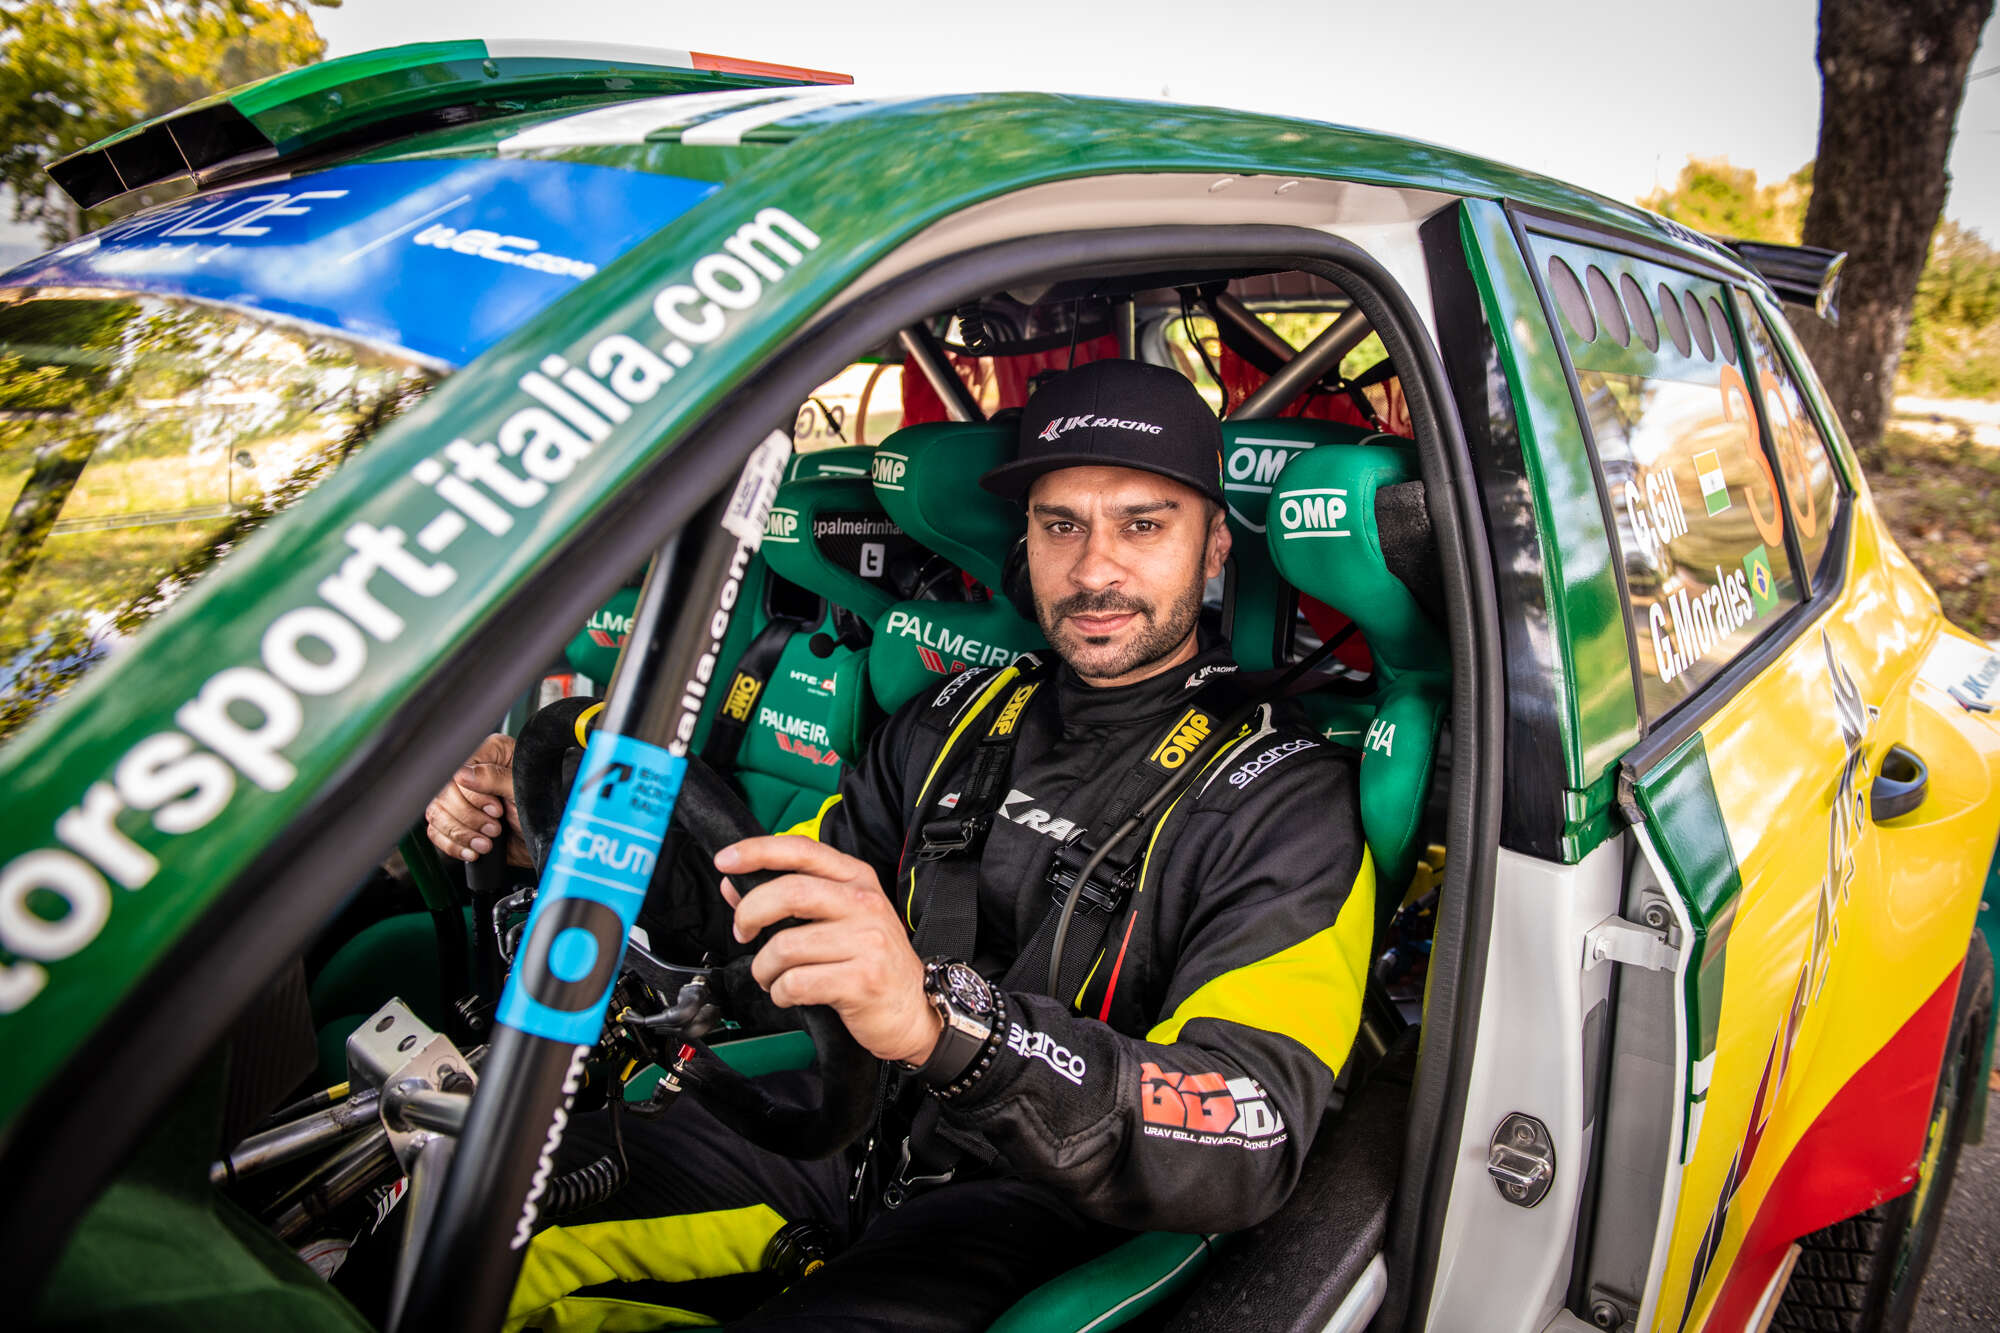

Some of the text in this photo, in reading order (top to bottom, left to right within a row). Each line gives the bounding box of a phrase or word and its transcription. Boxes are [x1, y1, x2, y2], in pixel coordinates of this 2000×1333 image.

[1059, 414, 1163, 435] JK RACING
[871, 457, 906, 484] OMP
[1227, 447, 1303, 484] OM
[1279, 496, 1347, 530] OMP
[1624, 467, 1688, 548] G.Gill
[1649, 565, 1754, 684] G.Morales
[731, 675, 757, 720] OMP
[998, 684, 1034, 736] OMP
[1159, 713, 1213, 769] OMP
[1228, 737, 1316, 787] sparco
[1007, 1021, 1086, 1085] sparco
[1172, 1131, 1197, 1142] GILL
